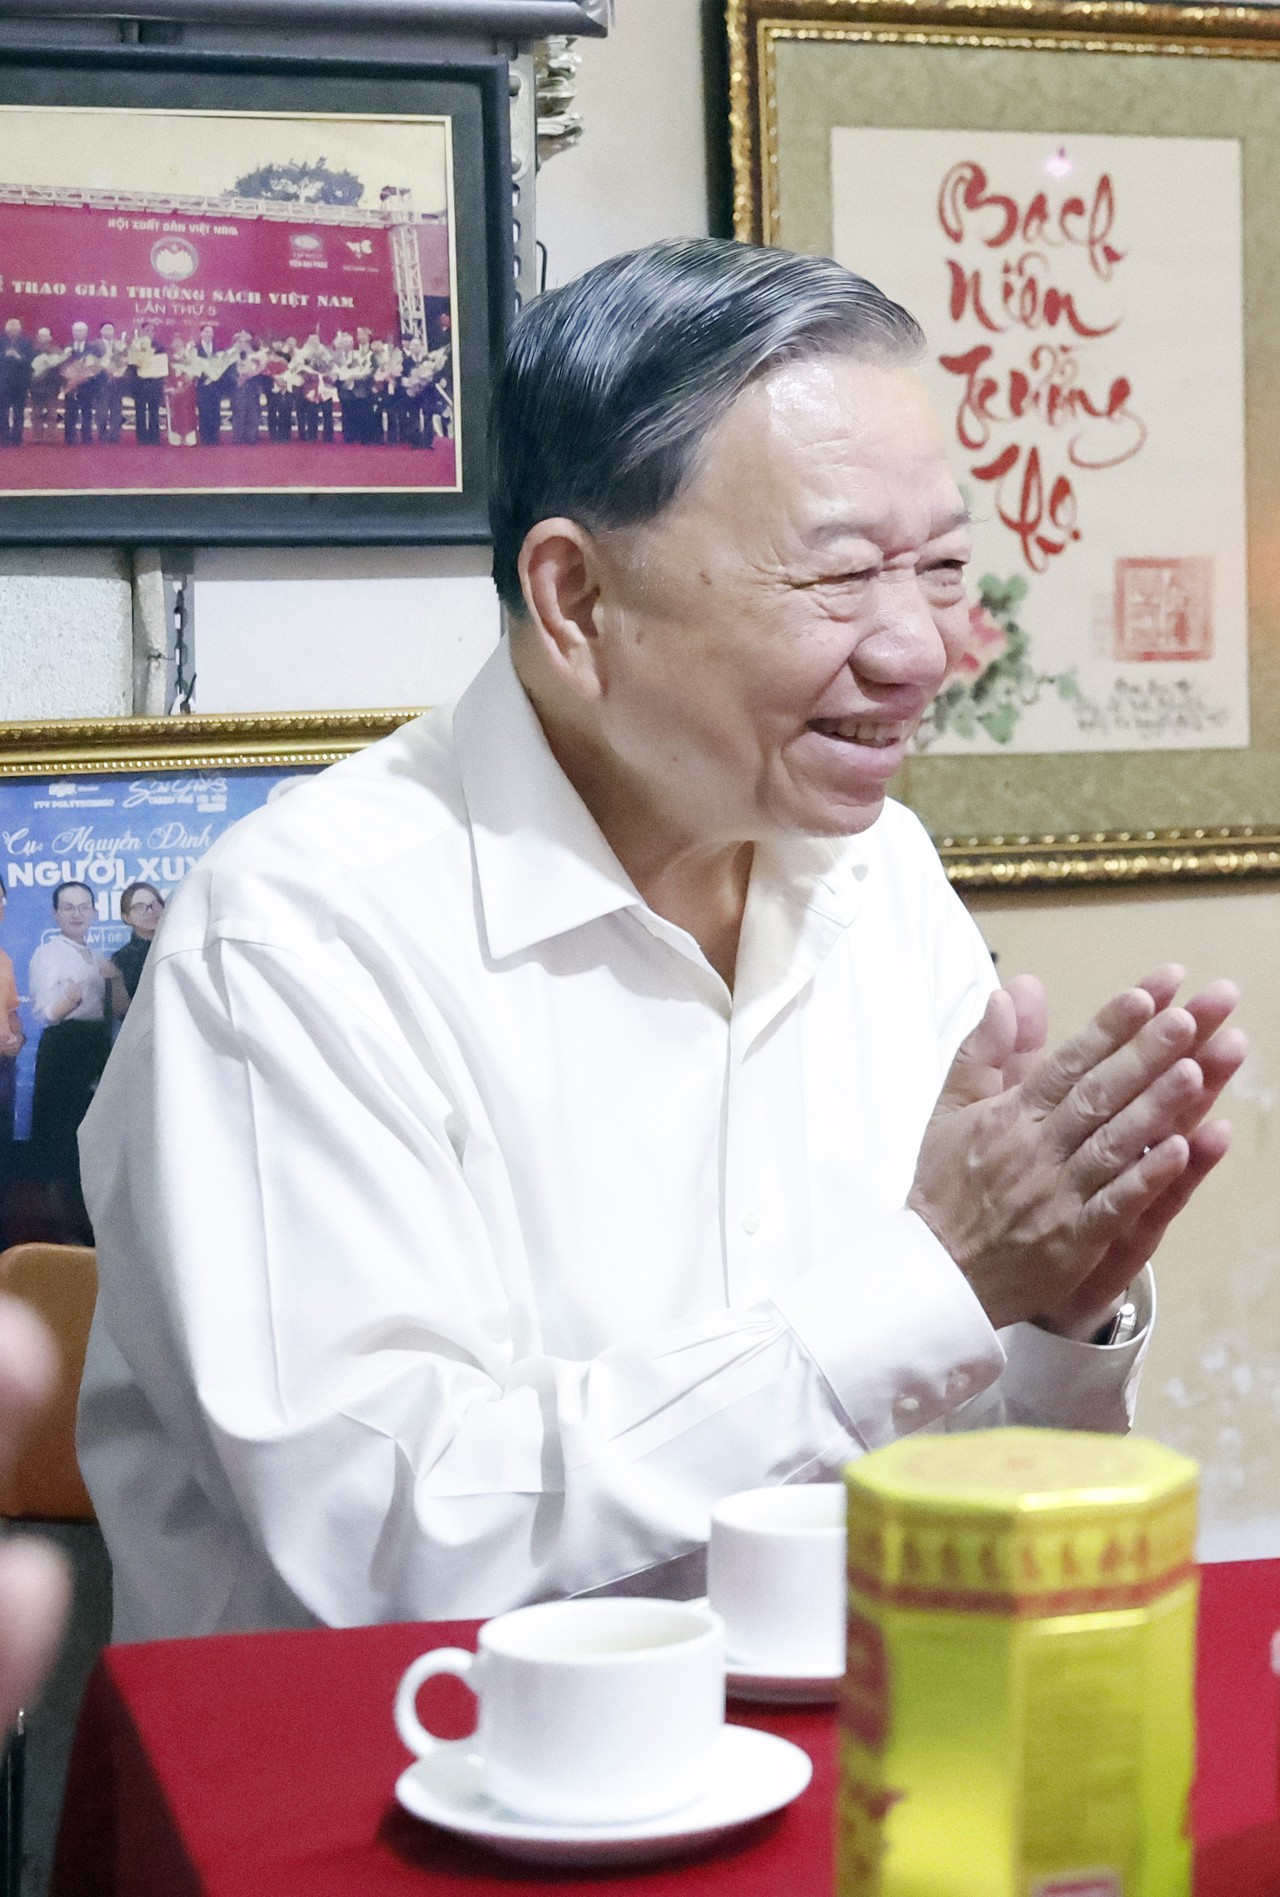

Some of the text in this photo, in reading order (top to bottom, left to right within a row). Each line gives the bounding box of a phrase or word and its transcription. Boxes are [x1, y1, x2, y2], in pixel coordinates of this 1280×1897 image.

[189, 223, 210, 236] VIỆT
[214, 226, 238, 236] NAM
[12, 281, 66, 294] TRAO
[75, 280, 117, 297] GIẢI
[213, 289, 261, 304] SÁCH
[269, 292, 309, 308] VIỆT
[317, 295, 354, 308] NAM
